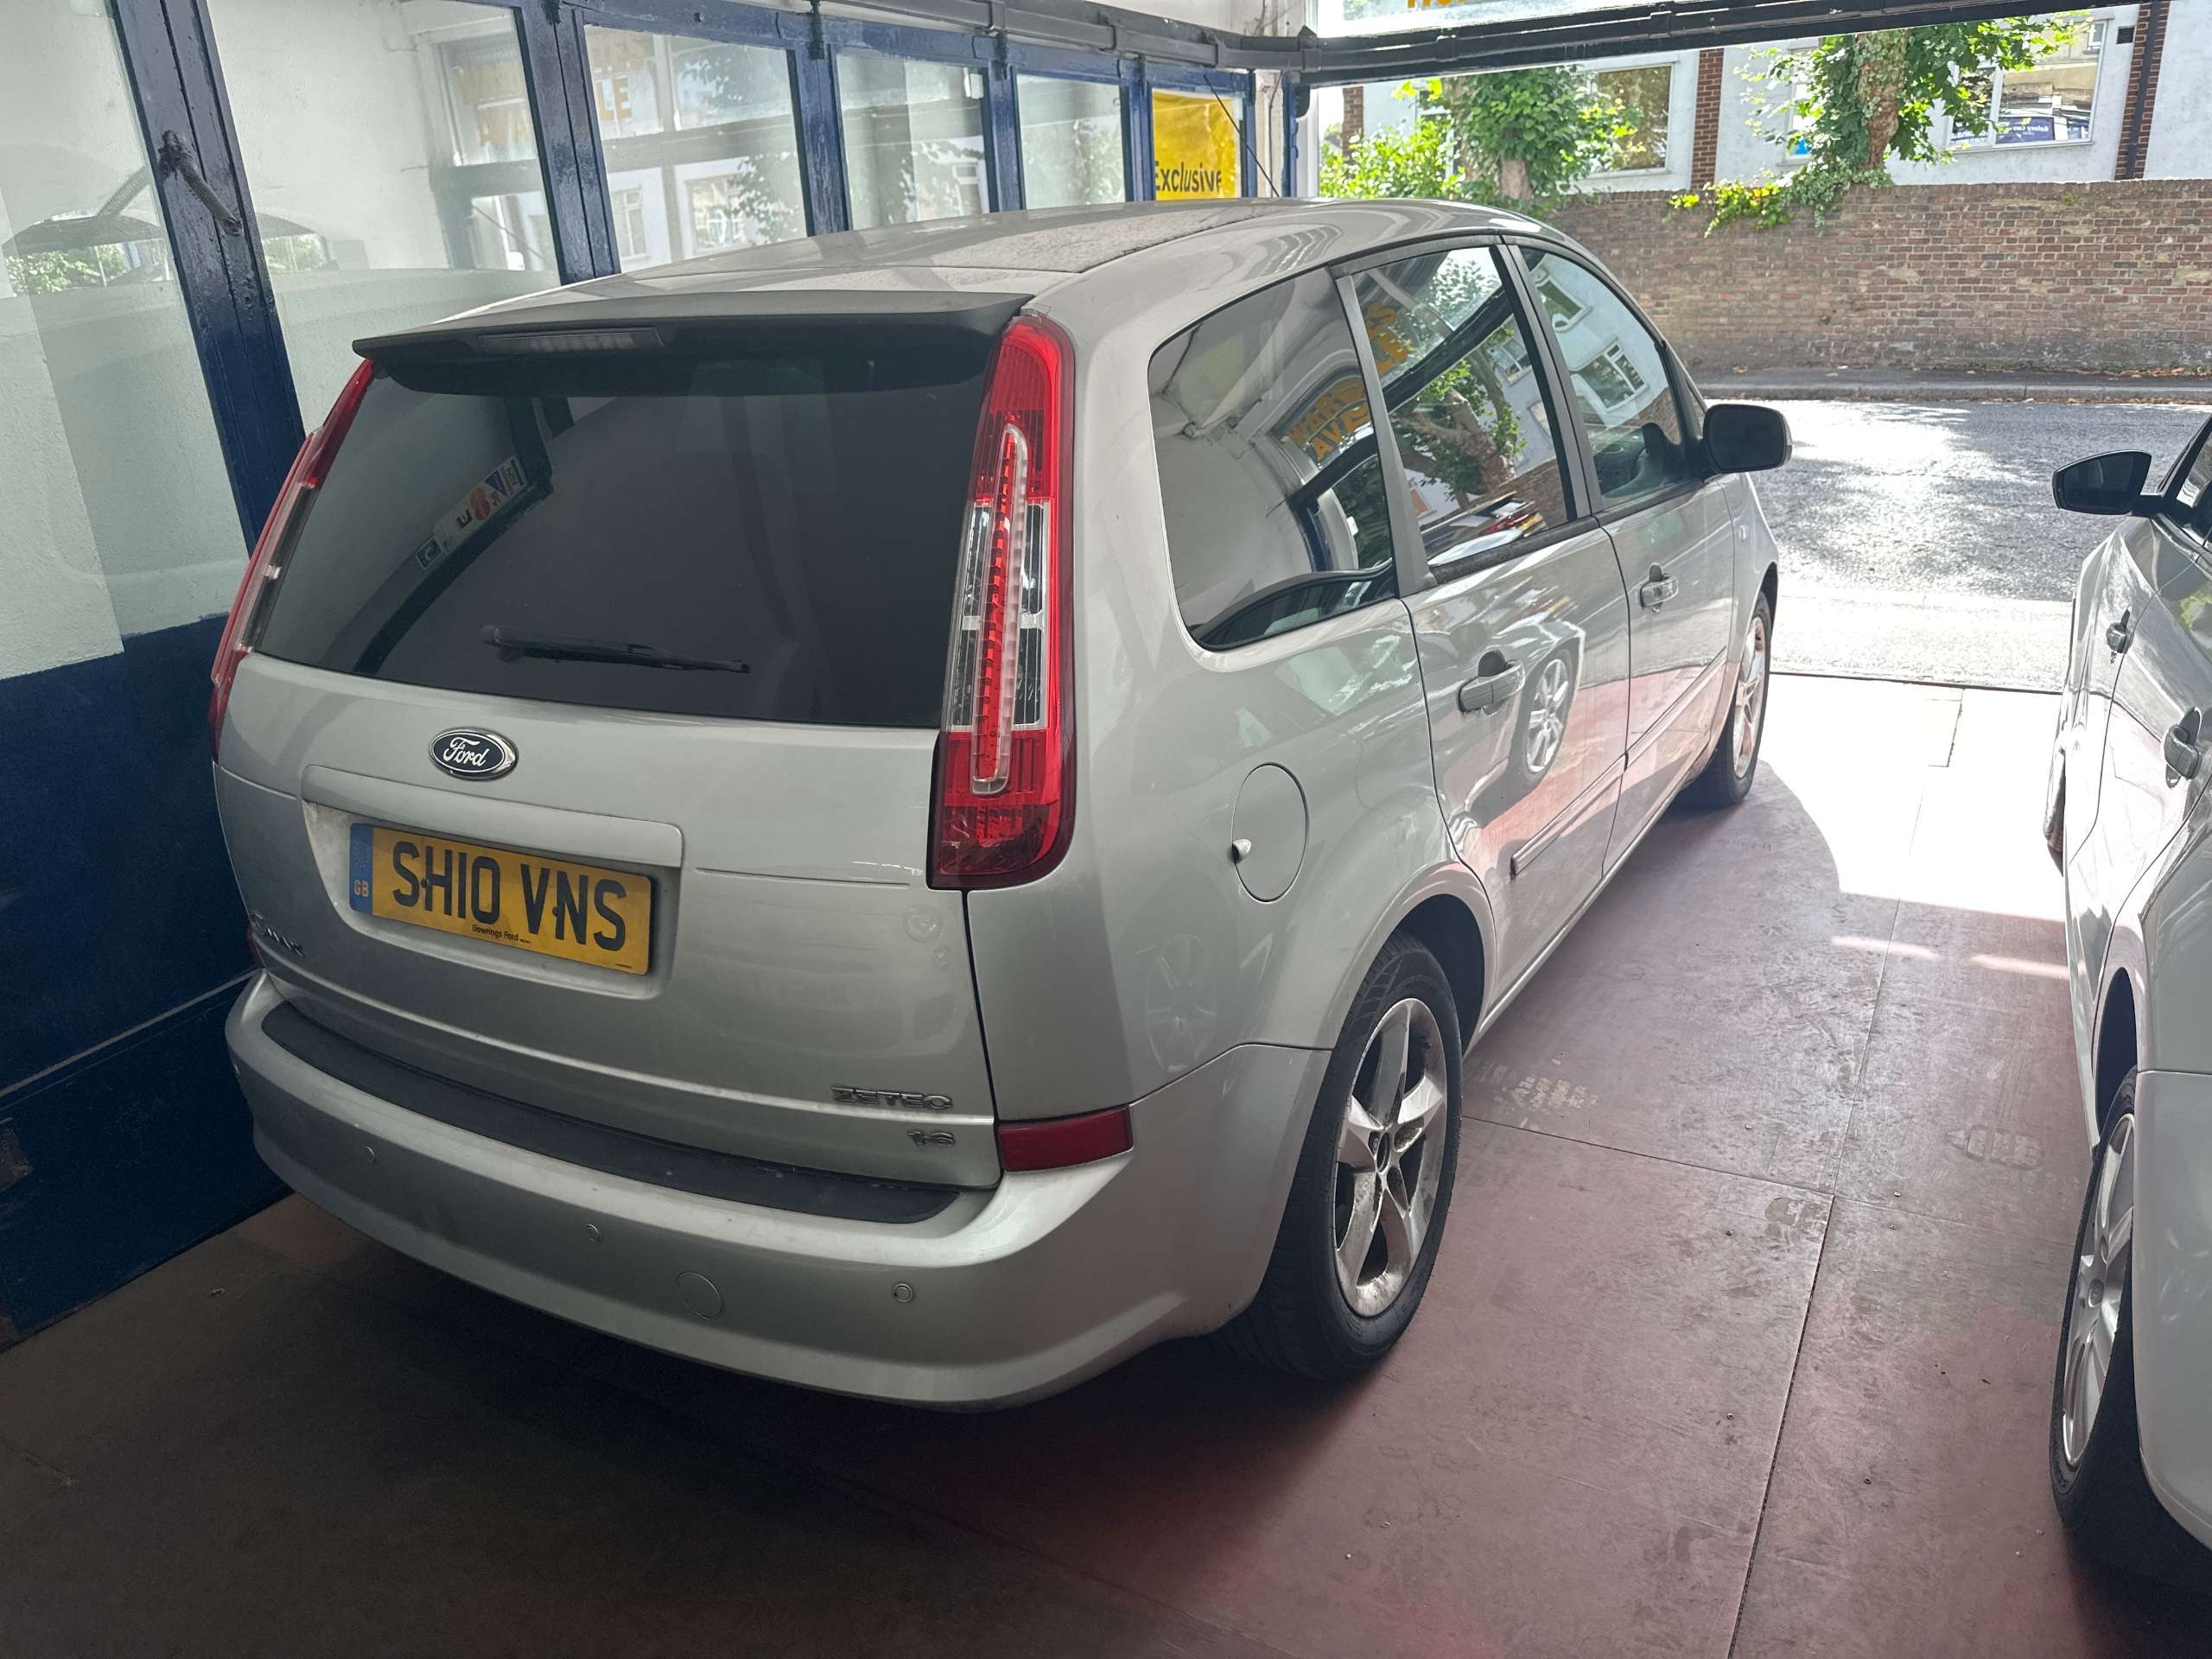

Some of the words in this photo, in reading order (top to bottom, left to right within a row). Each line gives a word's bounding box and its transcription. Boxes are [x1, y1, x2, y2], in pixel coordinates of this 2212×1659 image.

[443, 737, 490, 766] Ford
[354, 879, 369, 898] GB
[392, 841, 501, 925] SH10
[519, 863, 627, 951] VNS
[472, 925, 503, 939] Gowrings
[504, 929, 519, 942] Ford
